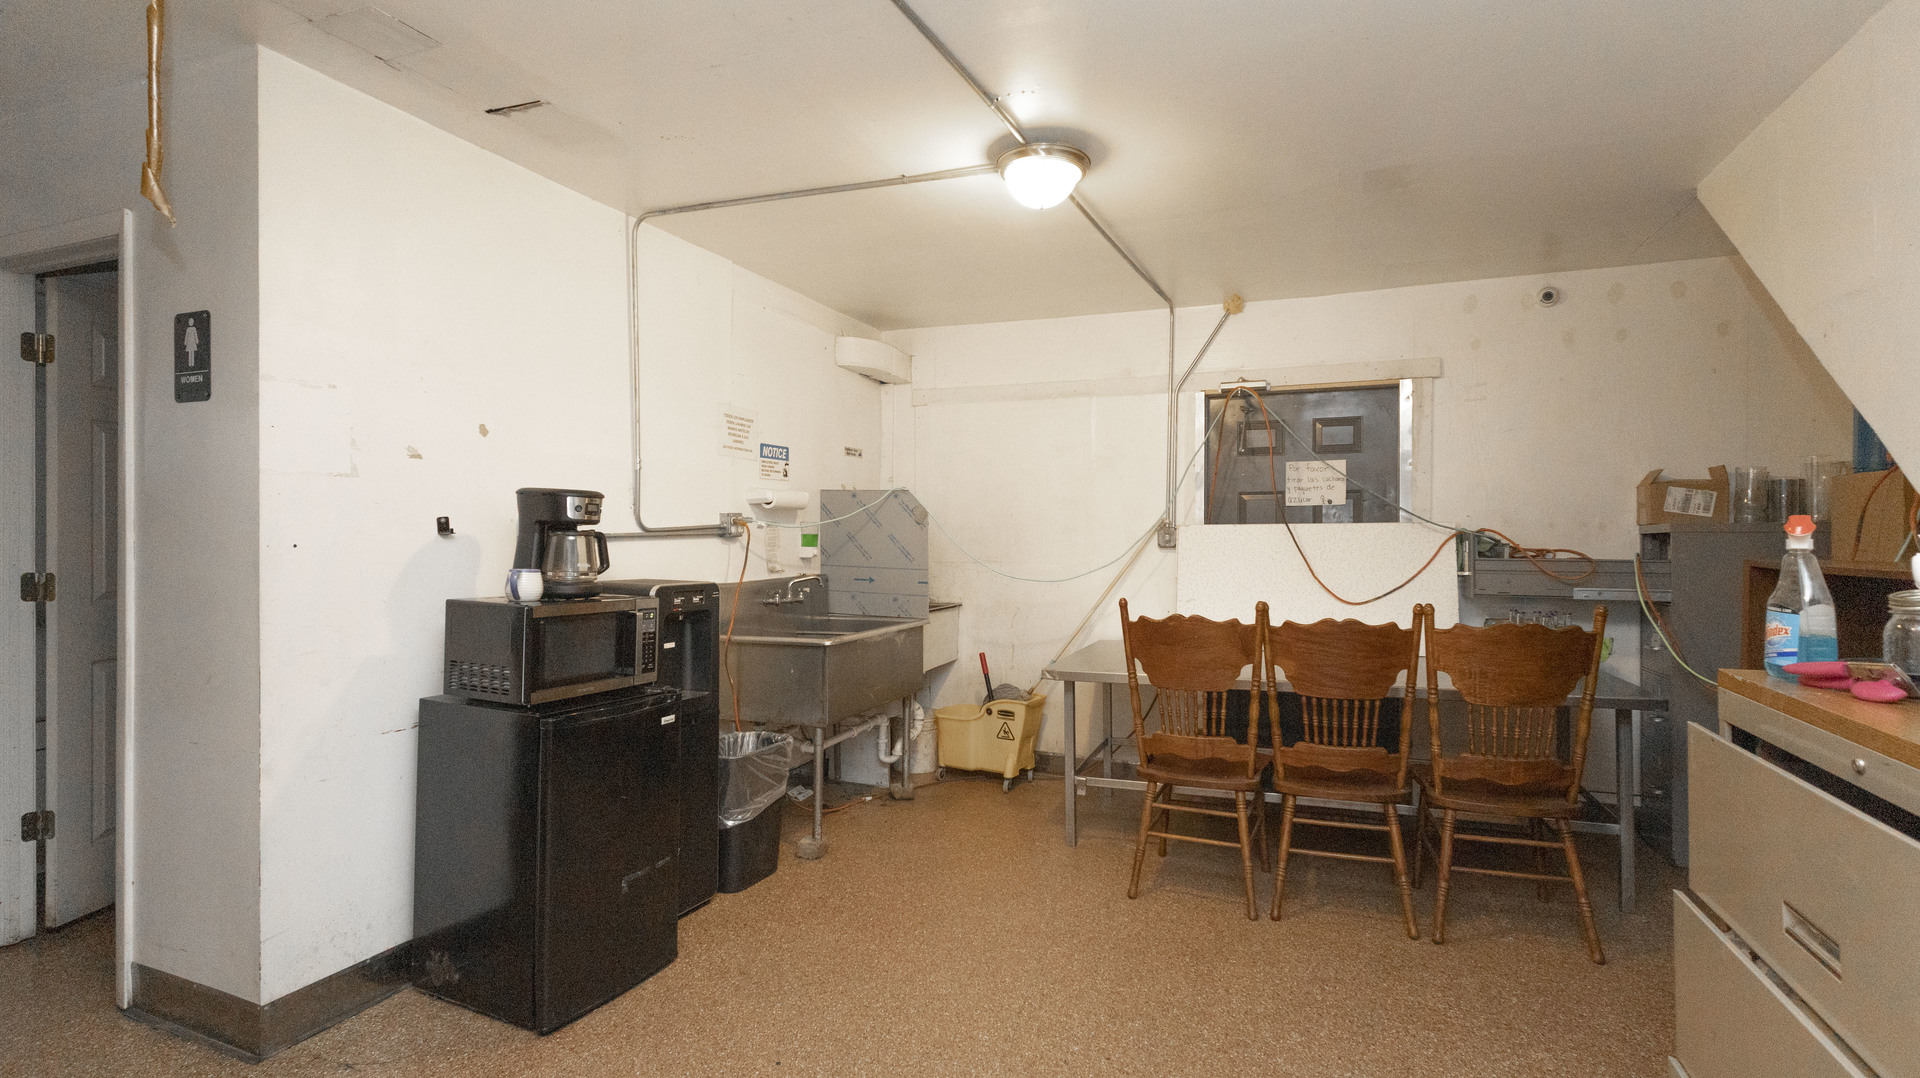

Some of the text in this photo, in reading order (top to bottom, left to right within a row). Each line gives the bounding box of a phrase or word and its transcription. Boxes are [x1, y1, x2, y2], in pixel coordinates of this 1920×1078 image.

[181, 375, 203, 384] WOMEN
[762, 446, 787, 459] NOTICE
[1306, 463, 1329, 473] favor
[1287, 486, 1291, 494] y
[1294, 485, 1323, 495] paquetes
